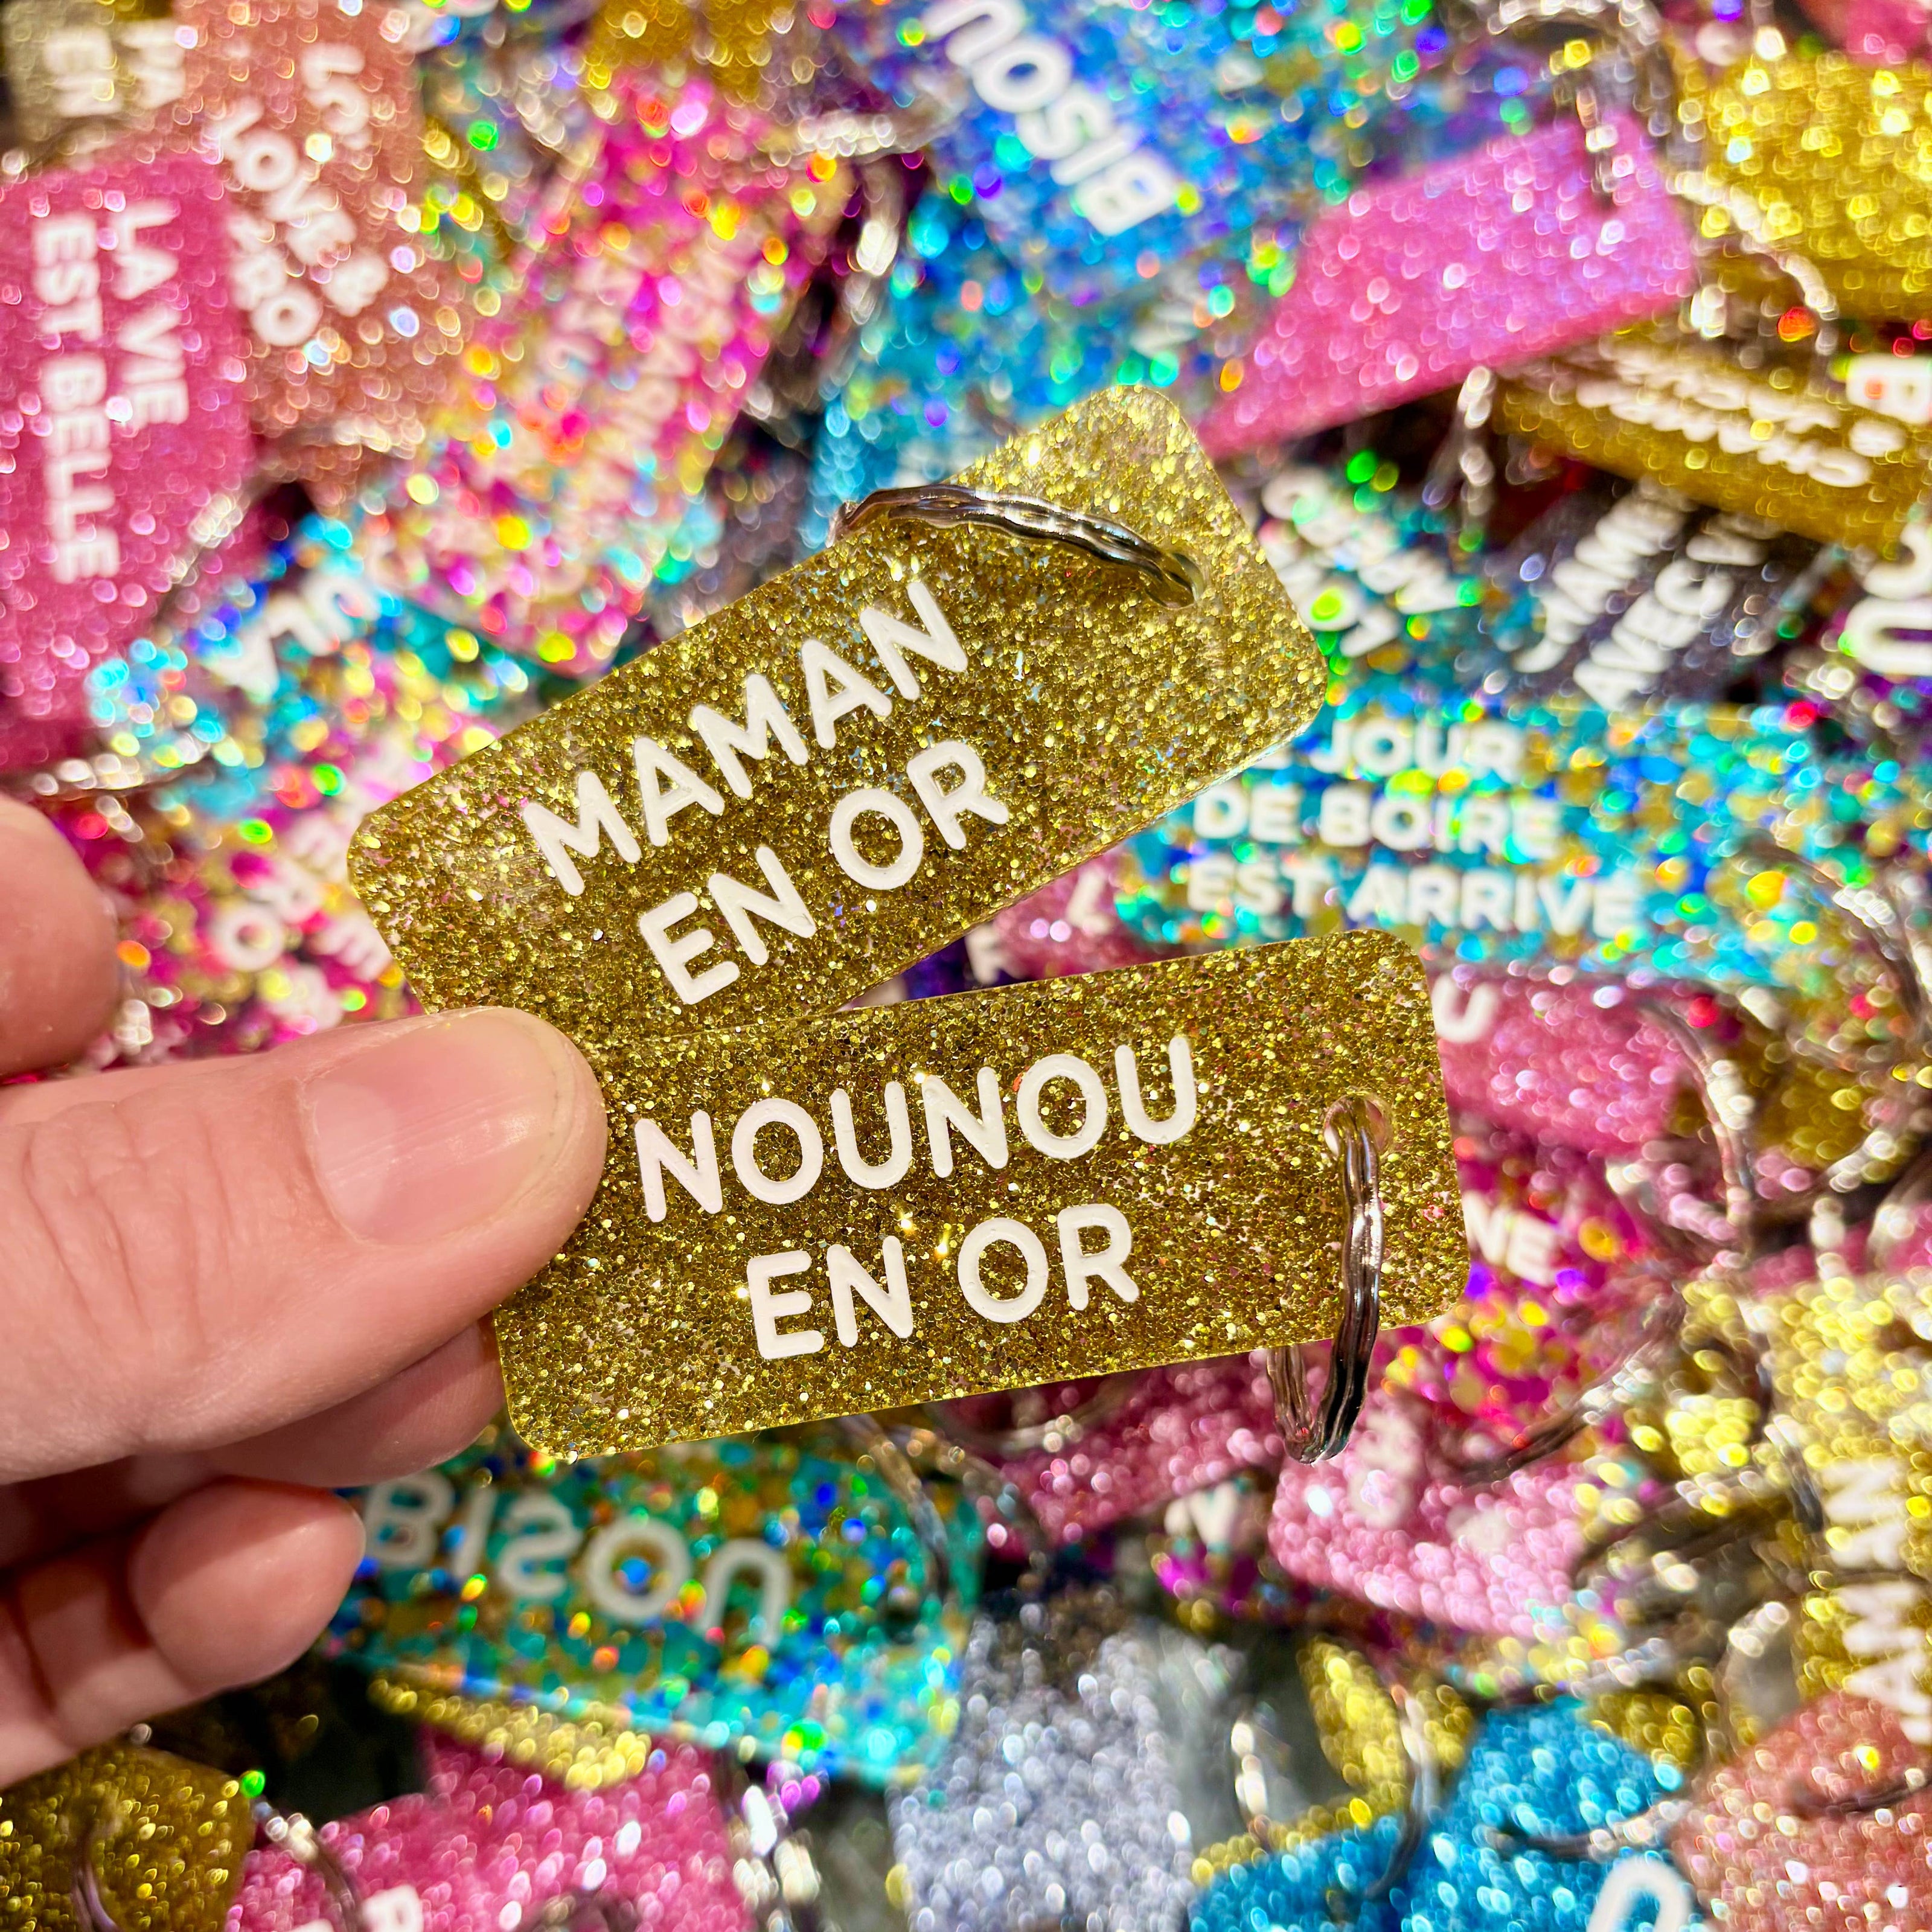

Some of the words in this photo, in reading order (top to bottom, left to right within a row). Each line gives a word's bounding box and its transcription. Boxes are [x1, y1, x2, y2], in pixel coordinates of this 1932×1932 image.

[208, 95, 359, 266] LOVE
[920, 0, 1180, 238] BISOU
[30, 214, 104, 343] EST
[110, 198, 180, 301] LA
[120, 301, 190, 425] VIE
[38, 351, 122, 584] BELLE
[523, 581, 969, 896] MAMAN
[1310, 717, 1526, 786] JOUR
[638, 845, 816, 1006] EN
[830, 740, 1009, 891] OR
[1185, 850, 1331, 921] EST
[1191, 784, 1304, 842] DE
[1318, 784, 1565, 861] BOIRE
[633, 1035, 1198, 1223] NOUNOU
[746, 1234, 915, 1361] EN
[956, 1203, 1140, 1324] OR
